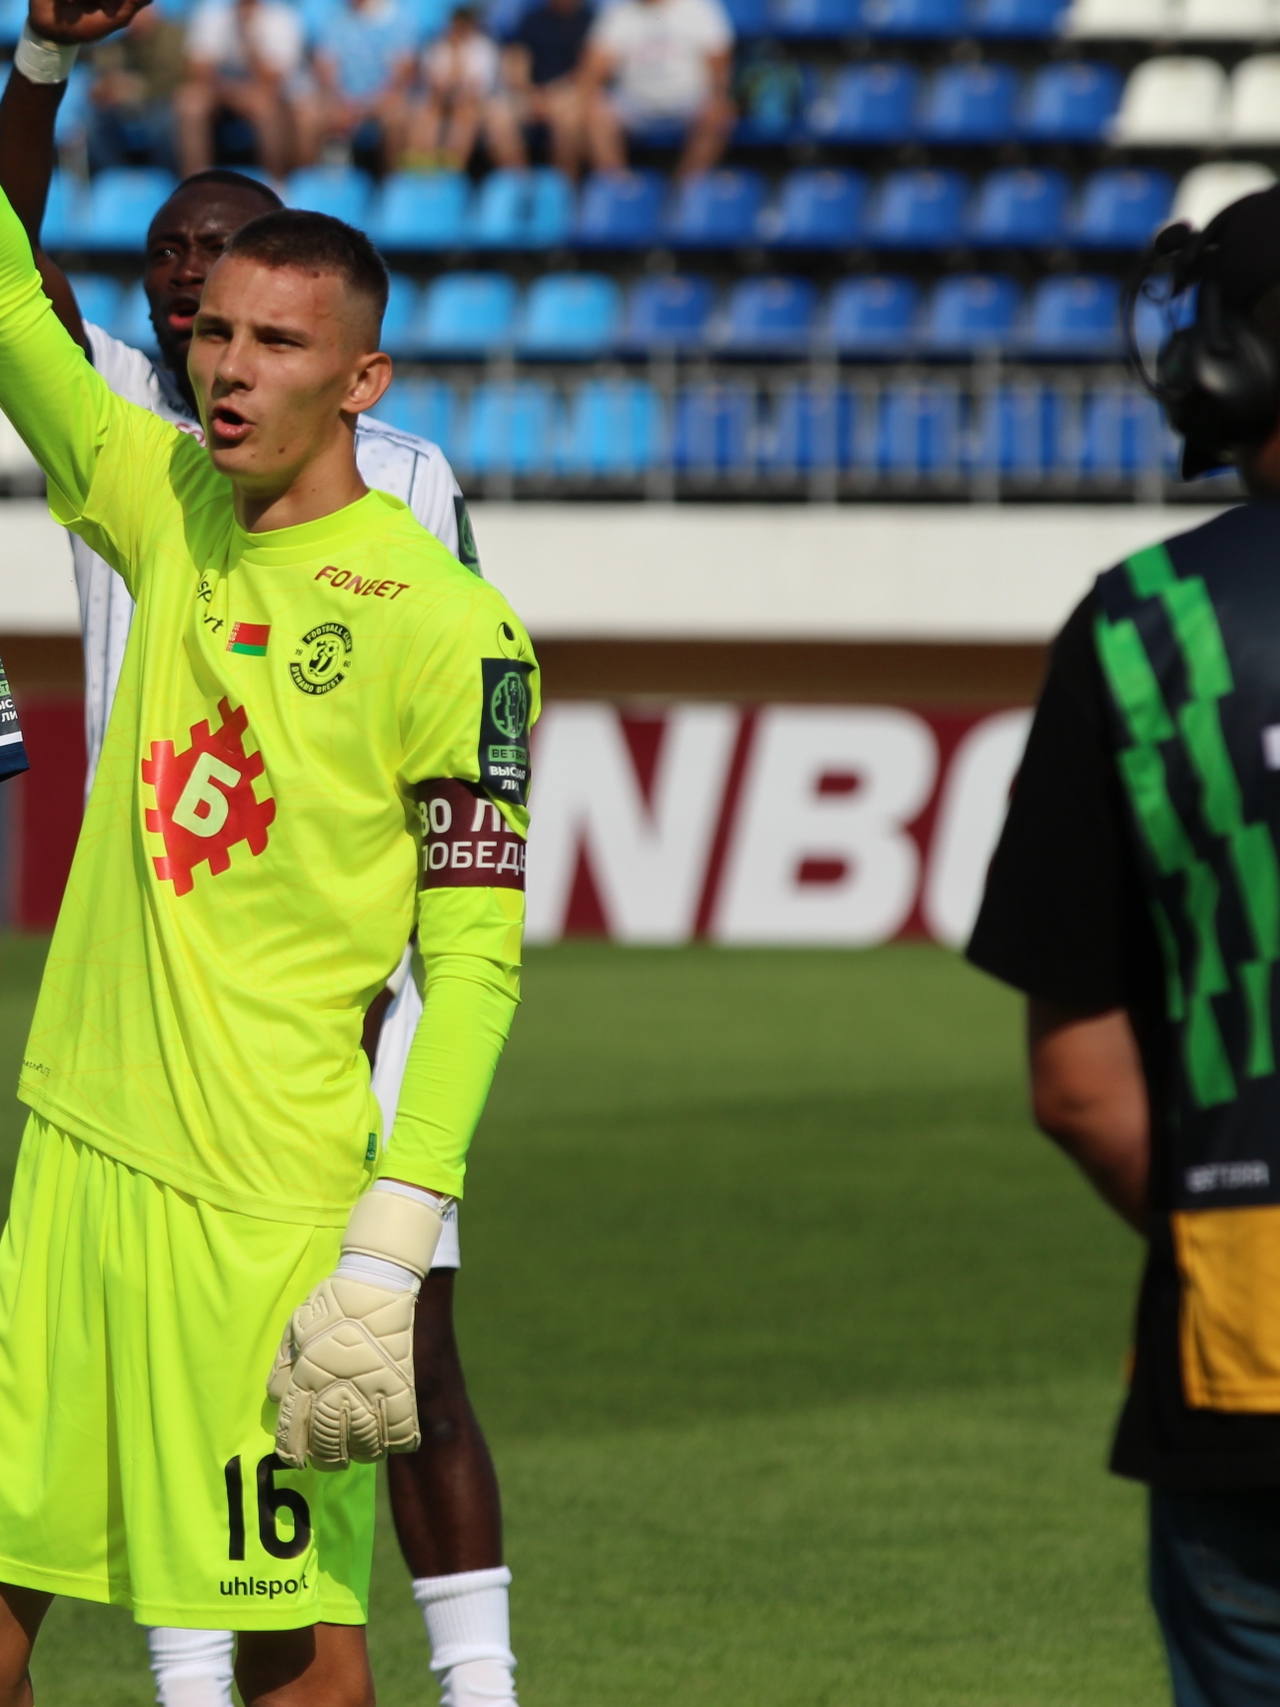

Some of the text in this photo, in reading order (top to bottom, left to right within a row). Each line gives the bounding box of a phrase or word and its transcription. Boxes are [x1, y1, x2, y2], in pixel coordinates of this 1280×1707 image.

[314, 565, 411, 600] FONBET
[306, 624, 344, 641] FOOTBALL
[291, 666, 340, 694] DYNAMO BREST
[171, 751, 242, 838] Б
[224, 1453, 312, 1561] 16
[220, 1572, 309, 1600] uhlspot
